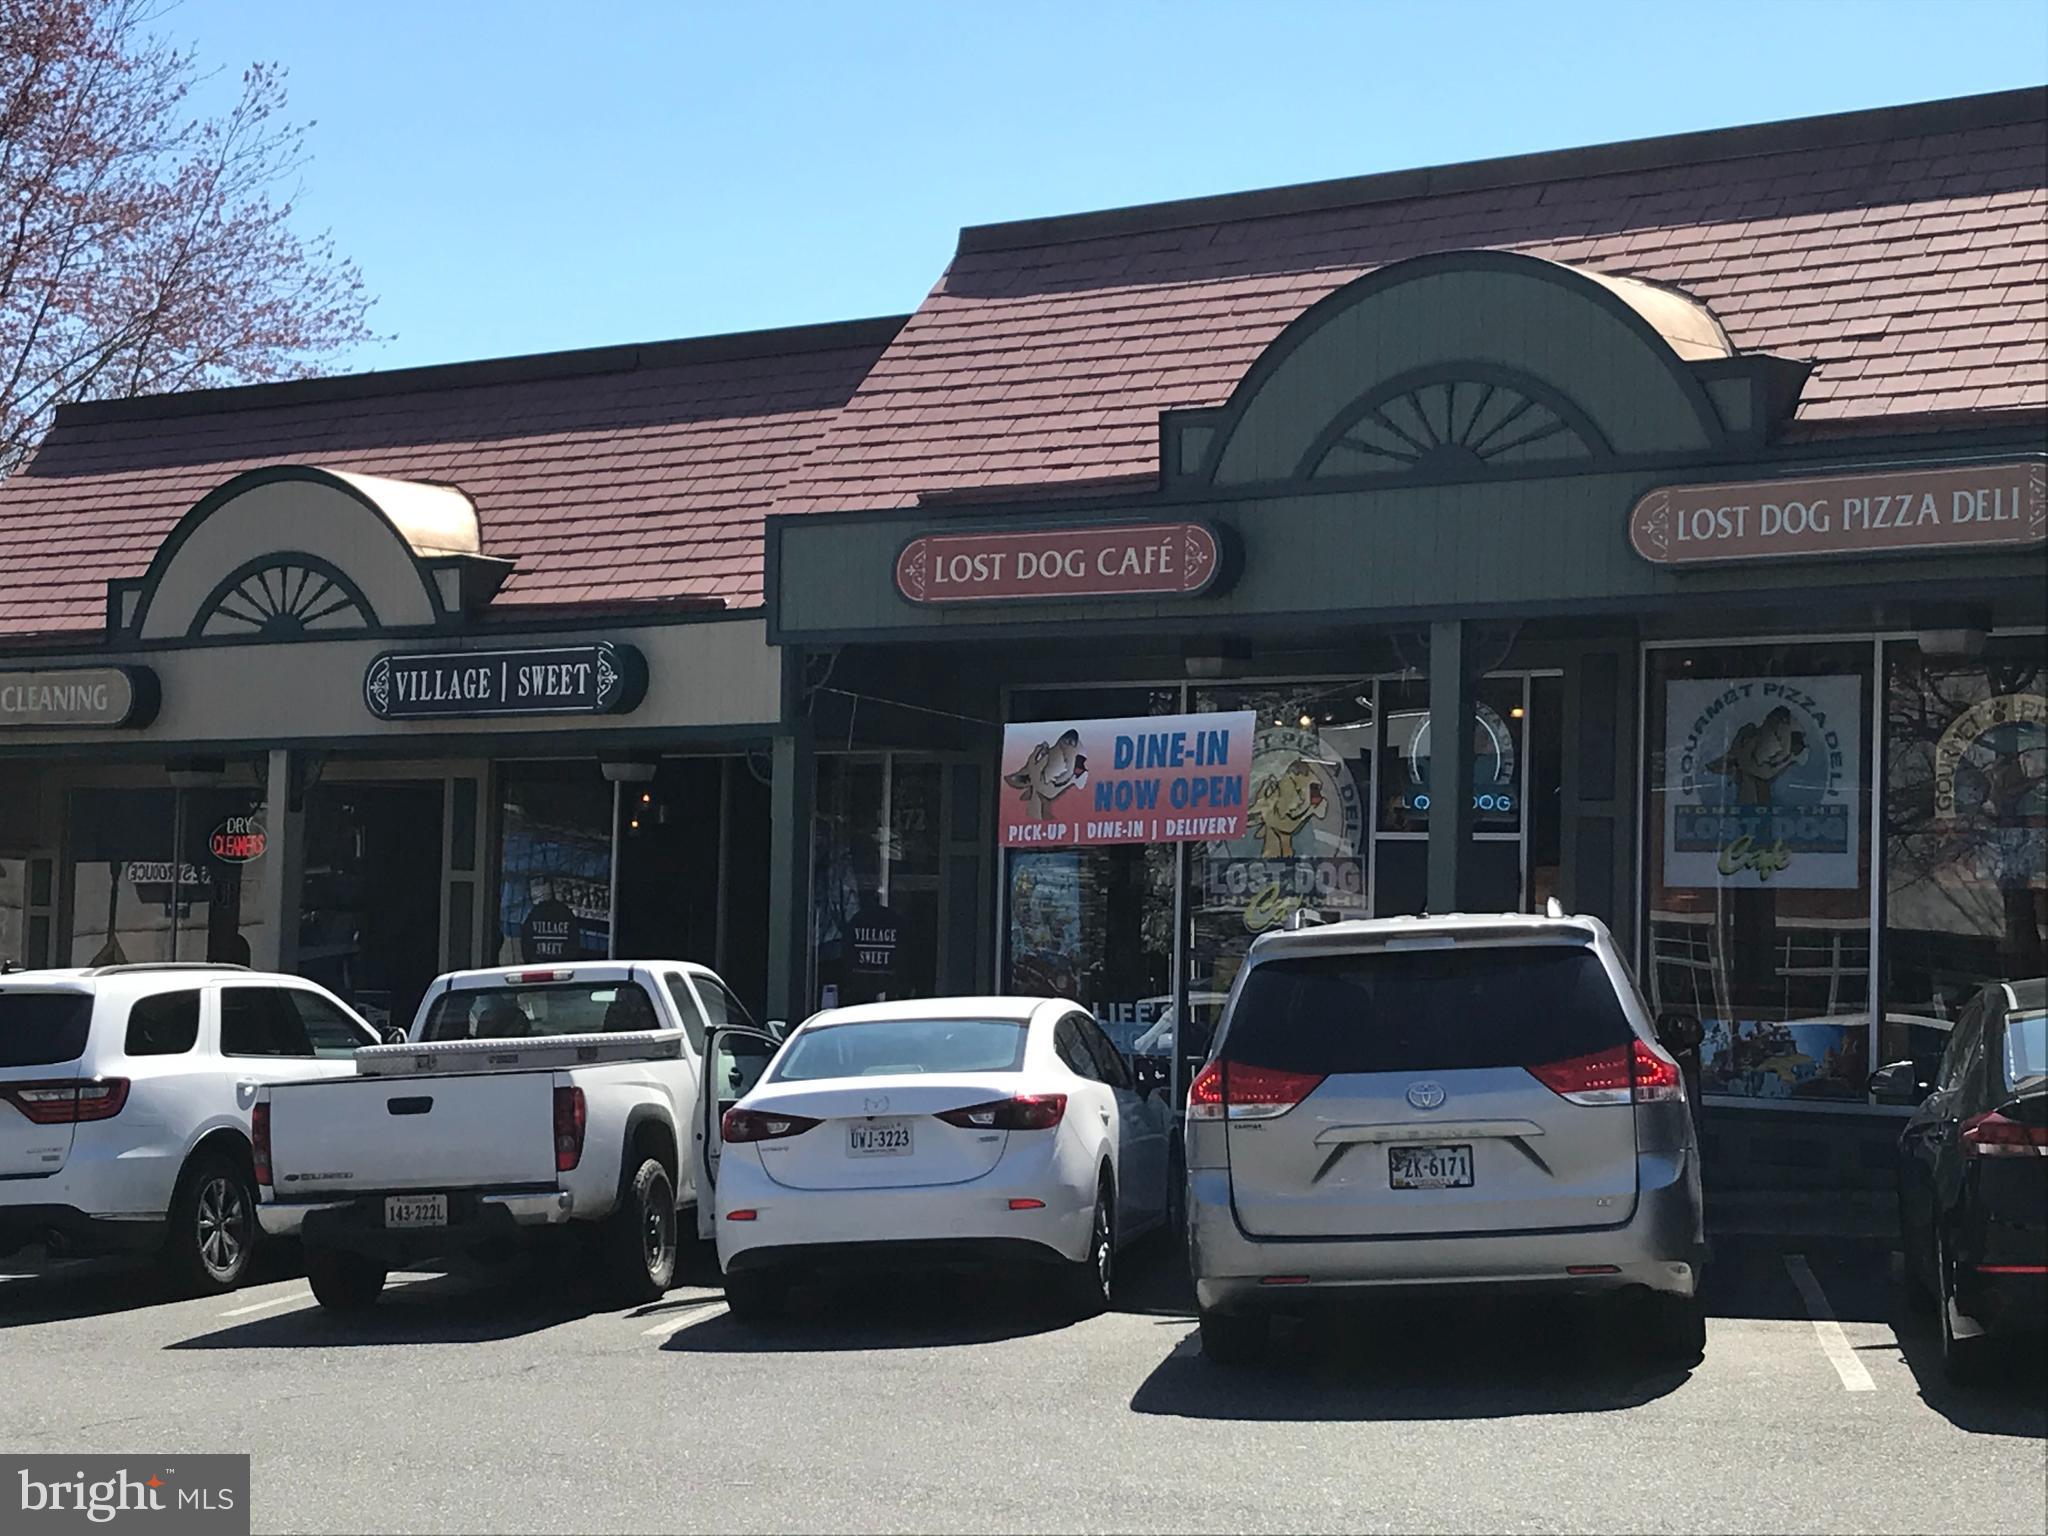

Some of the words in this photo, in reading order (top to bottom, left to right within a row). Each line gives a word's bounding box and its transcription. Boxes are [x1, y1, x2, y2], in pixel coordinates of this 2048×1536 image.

[1677, 505, 1750, 541] LOST
[1760, 500, 1830, 536] DOG
[1843, 493, 1941, 531] PIZZA
[1952, 486, 2020, 523] DELI
[934, 553, 1007, 583] LOST
[1016, 549, 1086, 580] DOG
[1097, 536, 1175, 577] CAFÉ
[1, 684, 108, 712] CLEANING
[395, 668, 491, 701] VILLAGE
[518, 663, 591, 697] SWEET
[1113, 729, 1230, 770] DINE-IN
[1763, 683, 1826, 728] PIZZA
[1825, 731, 1842, 796] DELI
[1094, 778, 1161, 812] NOW
[1170, 775, 1243, 809] OPEN
[226, 816, 253, 834] DRY
[1008, 823, 1068, 842] PICK-UP
[1087, 820, 1144, 839] DINE-IN
[1165, 816, 1238, 837] DELIVERY
[1208, 861, 1286, 894] LOST
[1295, 860, 1361, 894] DOG
[532, 921, 570, 934] VILLAGE
[854, 928, 897, 942] VILLAGE
[858, 951, 890, 964] SWEET
